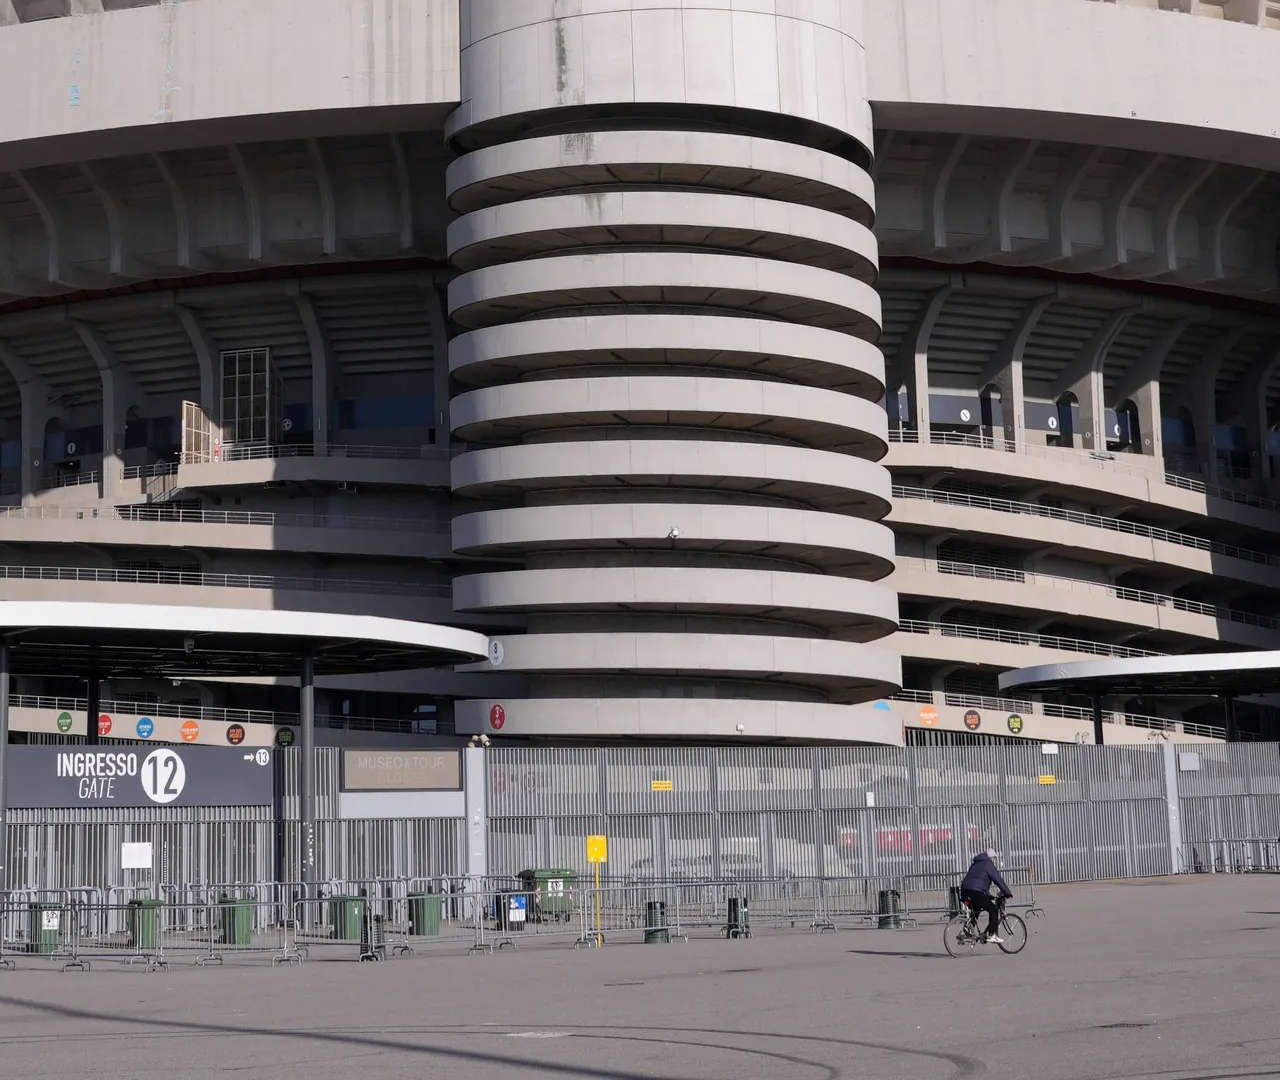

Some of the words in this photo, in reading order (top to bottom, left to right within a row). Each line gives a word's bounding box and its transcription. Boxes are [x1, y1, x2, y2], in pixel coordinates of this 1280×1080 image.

[257, 750, 268, 764] 13
[358, 756, 403, 769] MUSEO
[411, 756, 446, 769] TOUR
[57, 752, 137, 777] INGRESSO
[147, 755, 178, 795] 12
[78, 777, 116, 799] GATE
